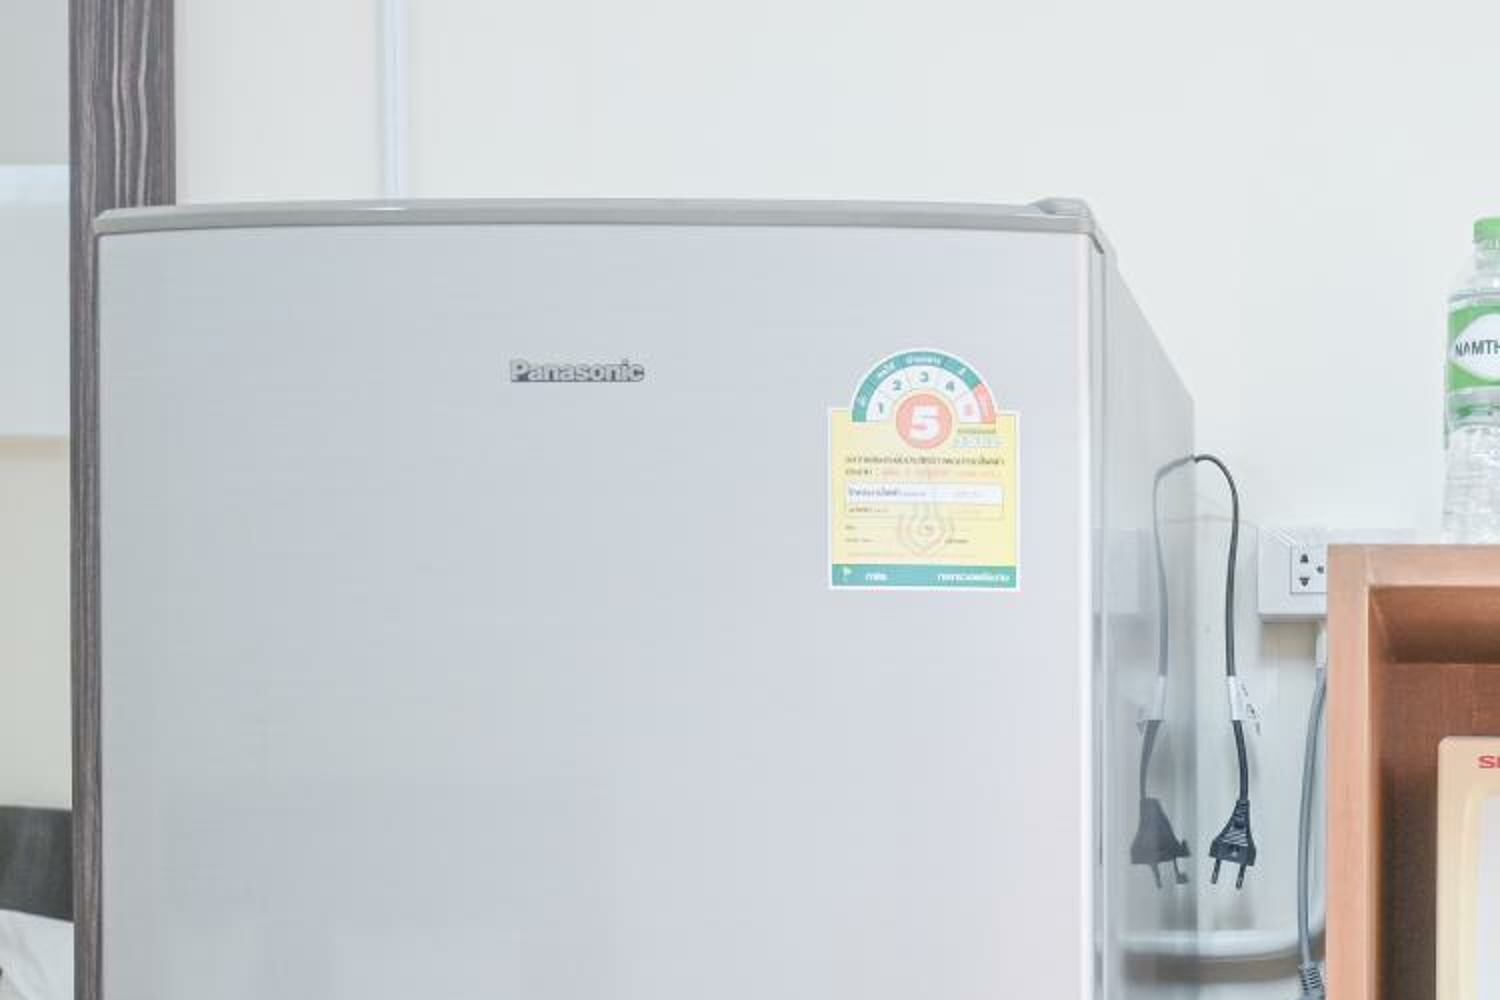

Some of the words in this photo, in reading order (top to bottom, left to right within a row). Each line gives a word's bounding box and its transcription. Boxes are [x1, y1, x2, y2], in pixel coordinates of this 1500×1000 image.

[510, 357, 645, 383] Panasonic
[893, 380, 902, 391] 2
[920, 371, 929, 382] 3
[945, 381, 955, 392] 4
[910, 404, 941, 439] 5
